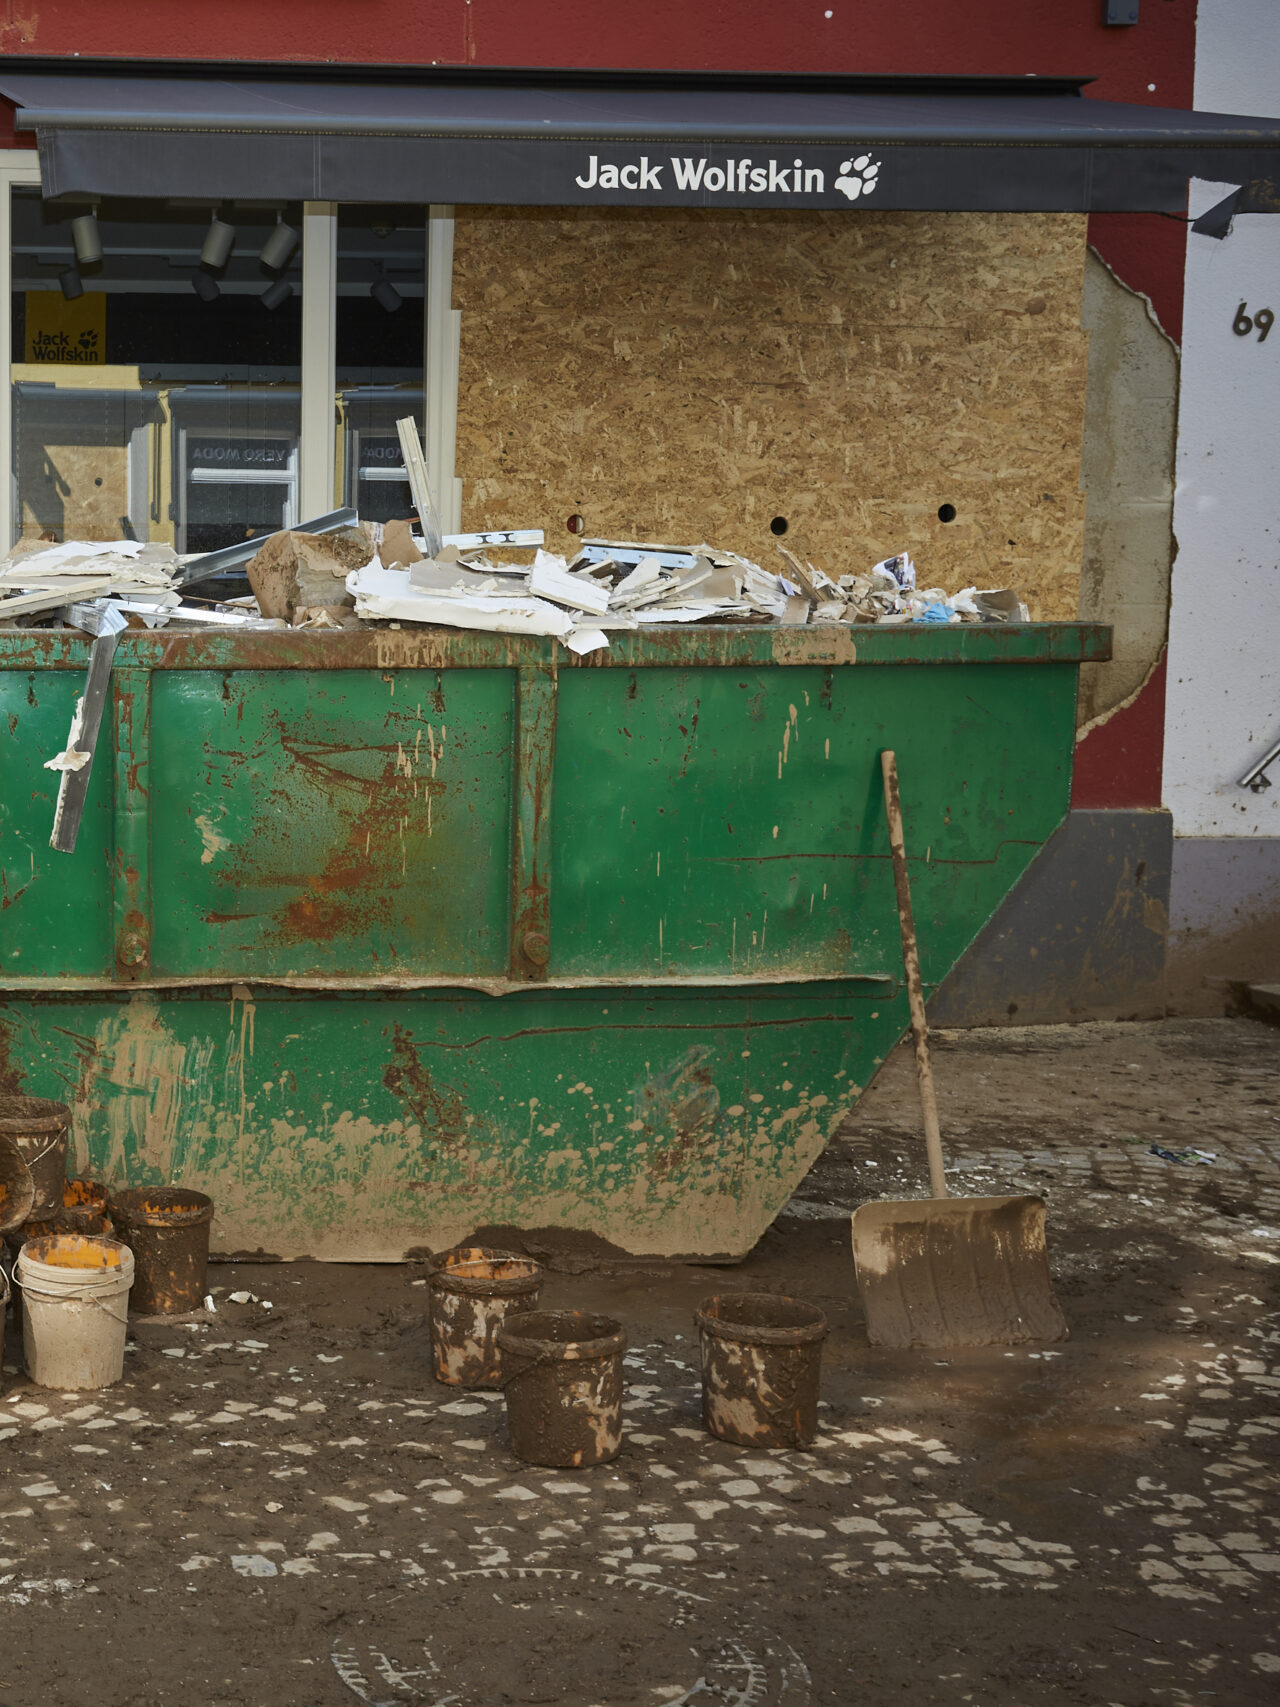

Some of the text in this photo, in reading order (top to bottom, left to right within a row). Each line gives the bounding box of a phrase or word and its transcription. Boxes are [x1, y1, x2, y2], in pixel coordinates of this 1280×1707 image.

[575, 155, 825, 193] Jack Wolfskin
[1232, 302, 1275, 342] 69
[32, 330, 70, 346] Jack
[32, 346, 99, 361] Wolfskin
